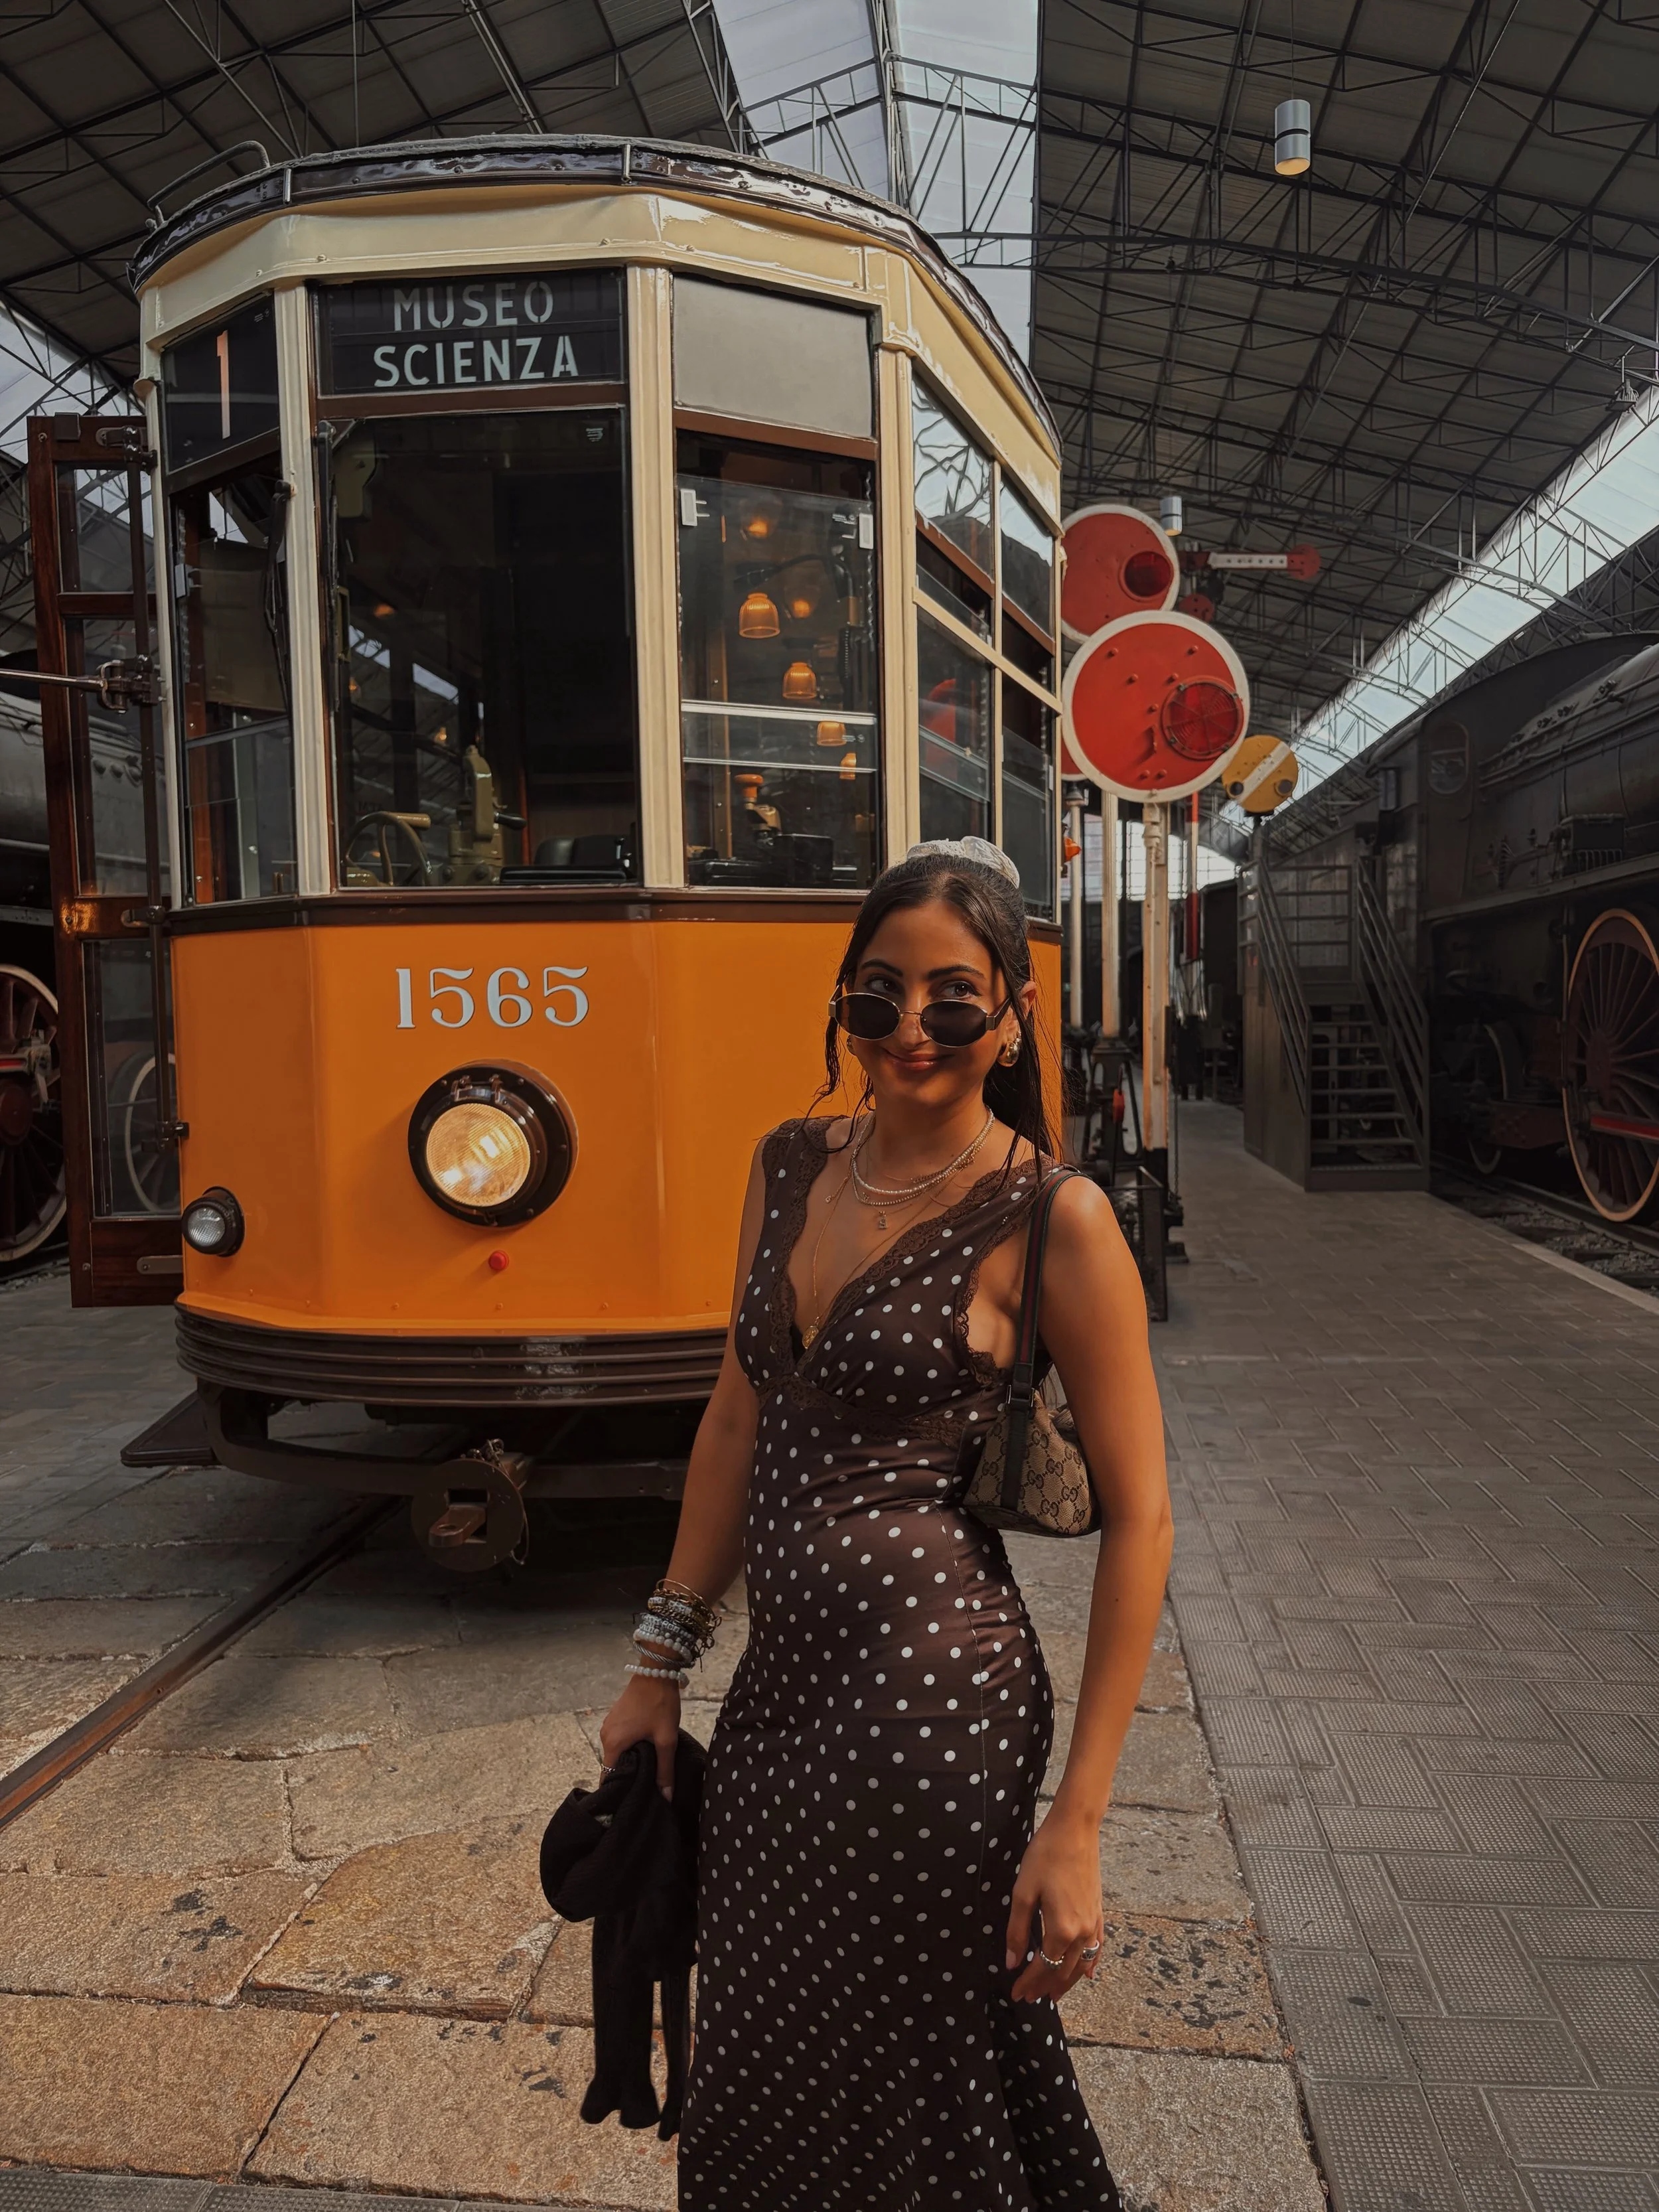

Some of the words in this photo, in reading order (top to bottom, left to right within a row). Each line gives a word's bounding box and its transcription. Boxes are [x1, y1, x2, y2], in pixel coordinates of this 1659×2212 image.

[393, 281, 554, 331] MUSEO
[216, 330, 231, 439] 1
[373, 335, 579, 388] SCIENZA
[396, 966, 589, 1028] 1565
